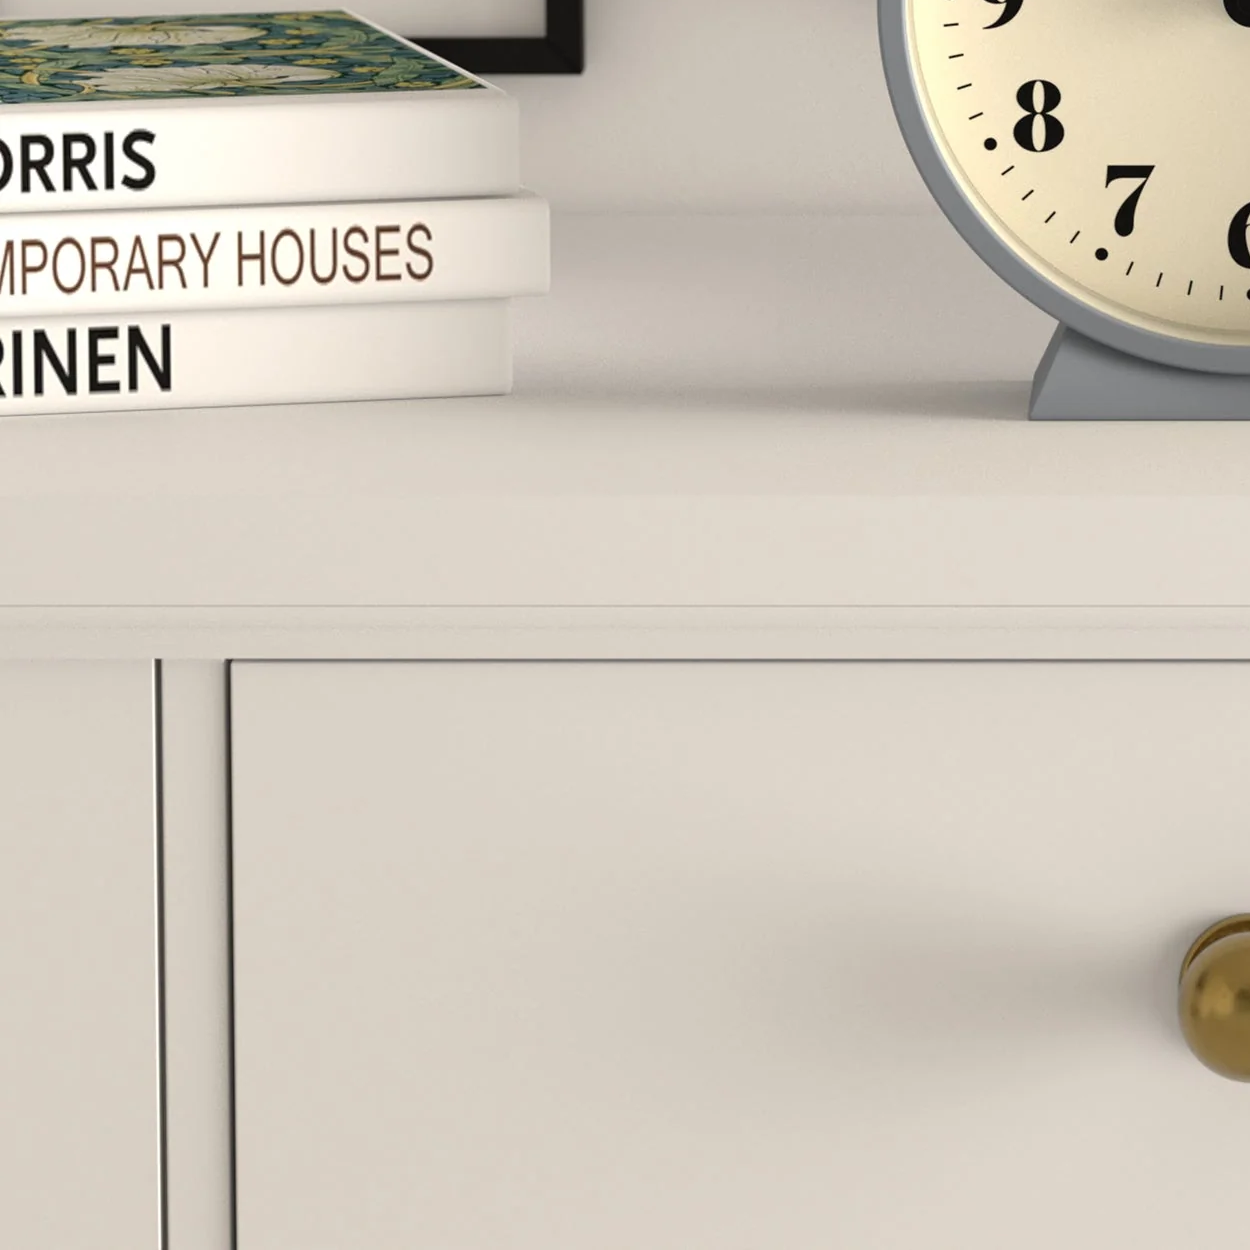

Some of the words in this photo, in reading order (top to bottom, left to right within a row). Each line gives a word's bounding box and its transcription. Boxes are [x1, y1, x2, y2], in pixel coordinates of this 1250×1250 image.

[1013, 79, 1065, 153] 8
[1104, 164, 1156, 238] 7
[237, 222, 434, 287] HOUSES
[0, 324, 172, 397] INEN
